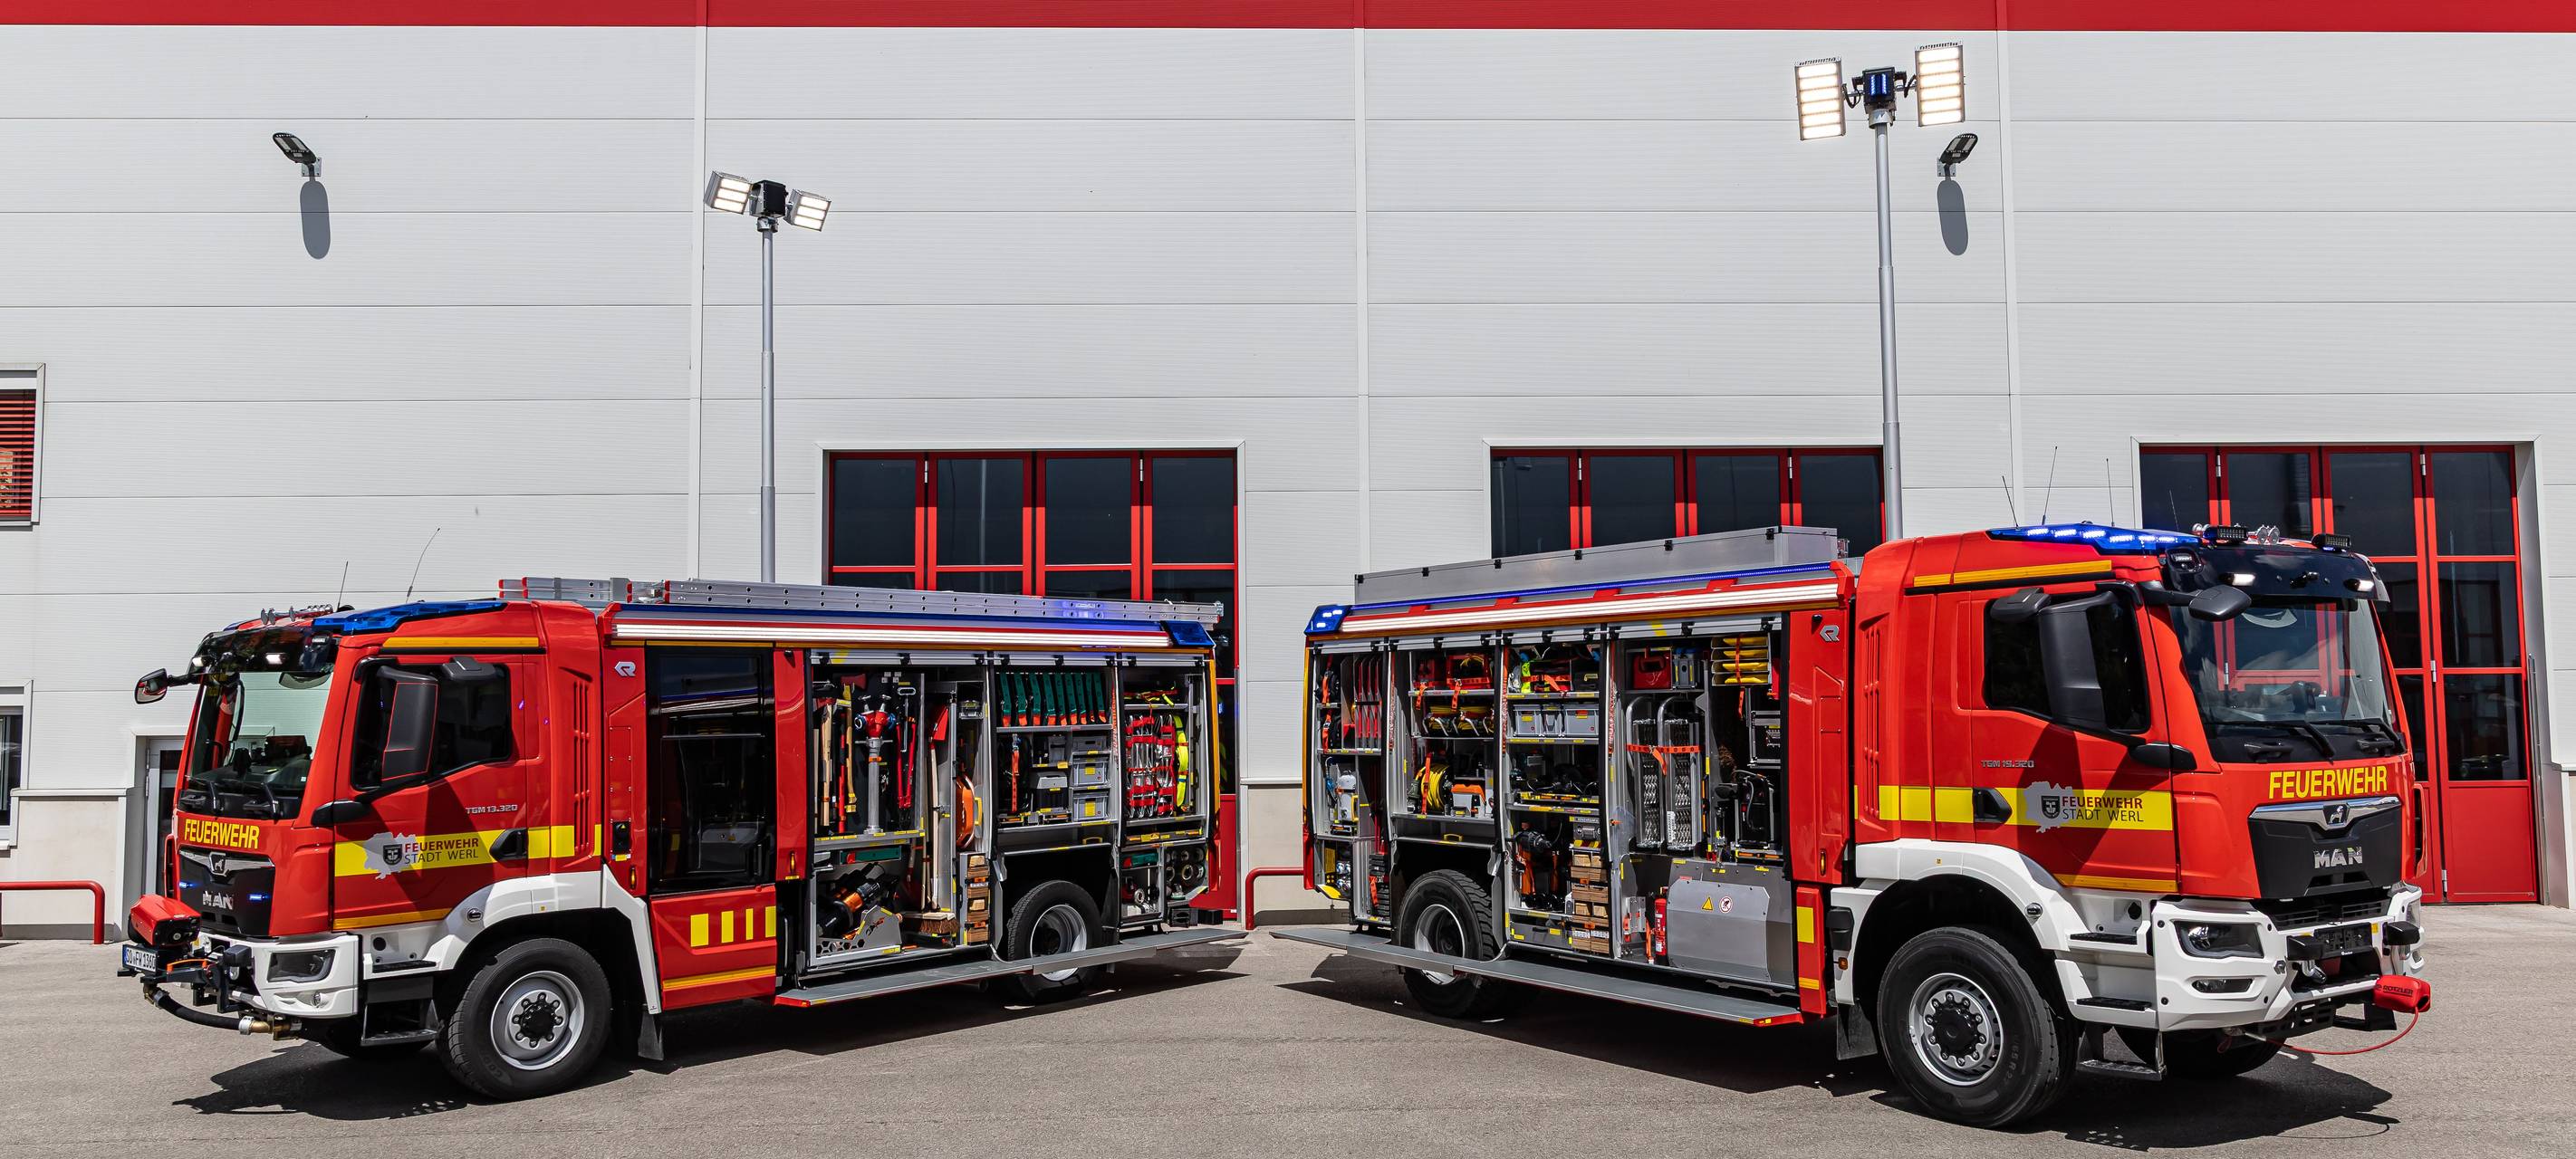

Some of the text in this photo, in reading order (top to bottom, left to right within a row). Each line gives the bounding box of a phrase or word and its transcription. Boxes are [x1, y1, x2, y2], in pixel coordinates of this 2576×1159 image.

[1981, 760, 2000, 768] TGM
[2269, 766, 2387, 799] FEUERWEHR
[486, 804, 518, 813] 13.320
[2062, 797, 2143, 809] FEUERWEHR
[2062, 809, 2144, 822] STADT WERL
[185, 819, 260, 849] FEUERWEHR
[405, 838, 479, 853] FEUERWEHR
[405, 849, 479, 865] STADT WERL
[2313, 847, 2363, 869] MAN
[202, 890, 234, 910] MAN
[127, 948, 132, 963] SO
[2383, 984, 2413, 996] ROTZLER
